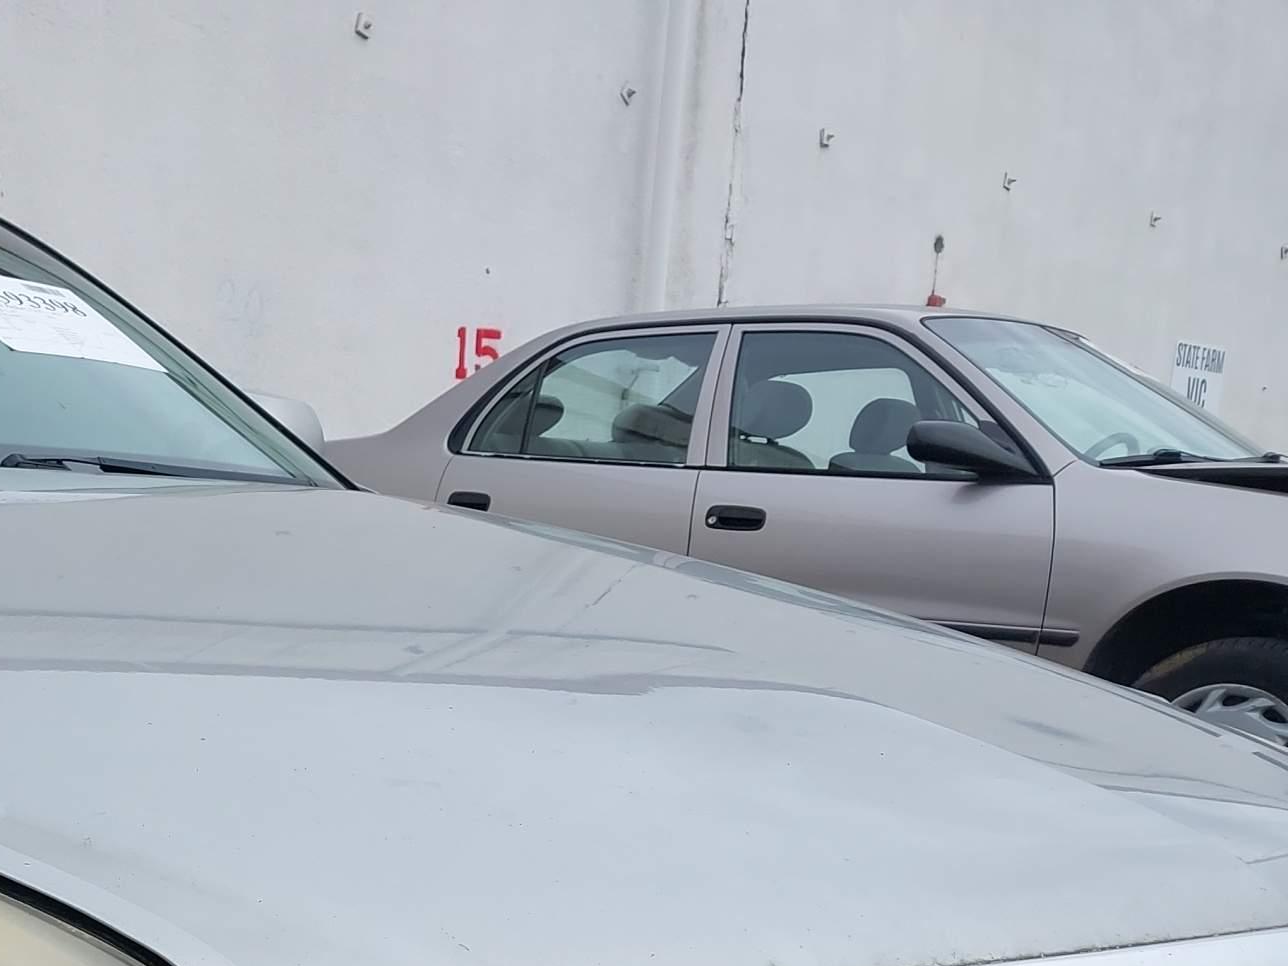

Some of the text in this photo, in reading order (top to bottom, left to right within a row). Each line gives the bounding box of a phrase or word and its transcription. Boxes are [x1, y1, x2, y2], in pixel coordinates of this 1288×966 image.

[455, 326, 501, 380] 15
[1176, 342, 1226, 374] STATE FARM
